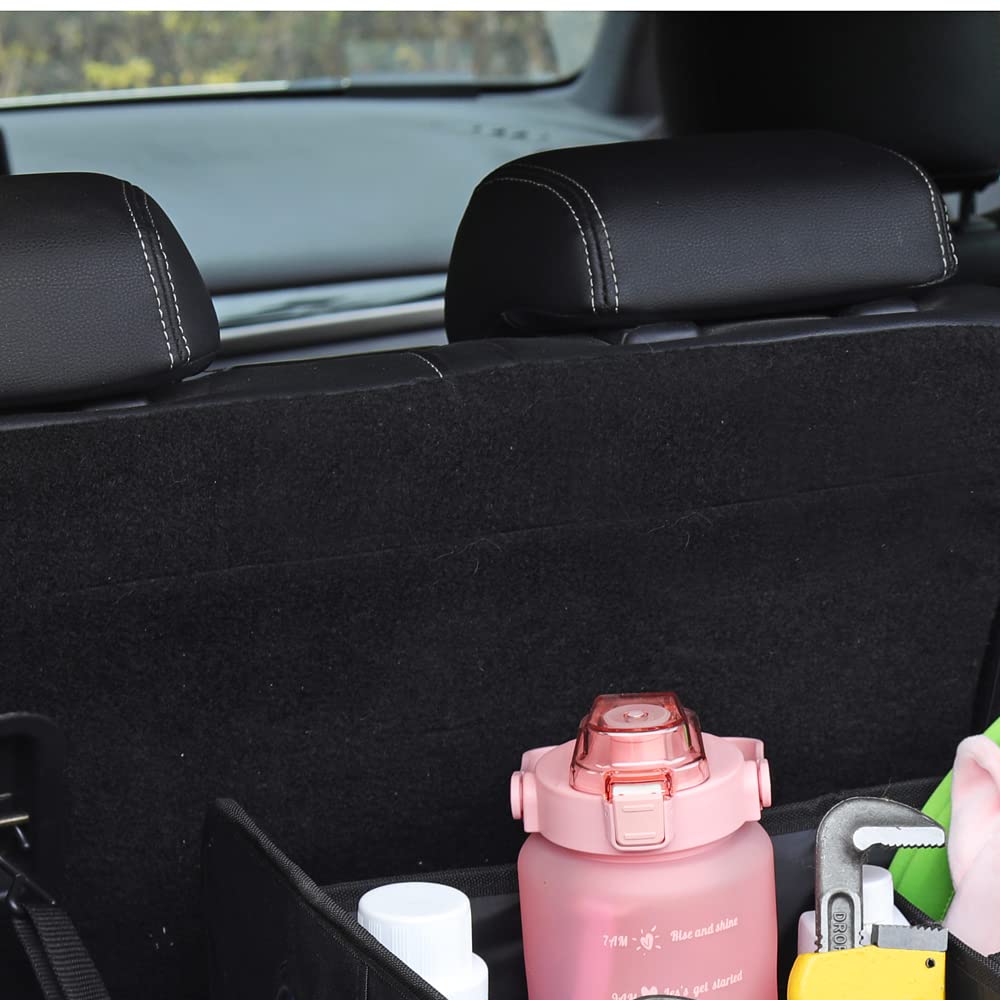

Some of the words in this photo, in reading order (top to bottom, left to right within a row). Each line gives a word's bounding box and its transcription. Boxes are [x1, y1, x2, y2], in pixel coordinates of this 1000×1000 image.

[603, 935, 628, 947] 7AM
[670, 929, 693, 942] Rise
[694, 923, 714, 938] and
[715, 917, 739, 932] shine
[693, 982, 708, 997] get
[712, 970, 743, 990] started
